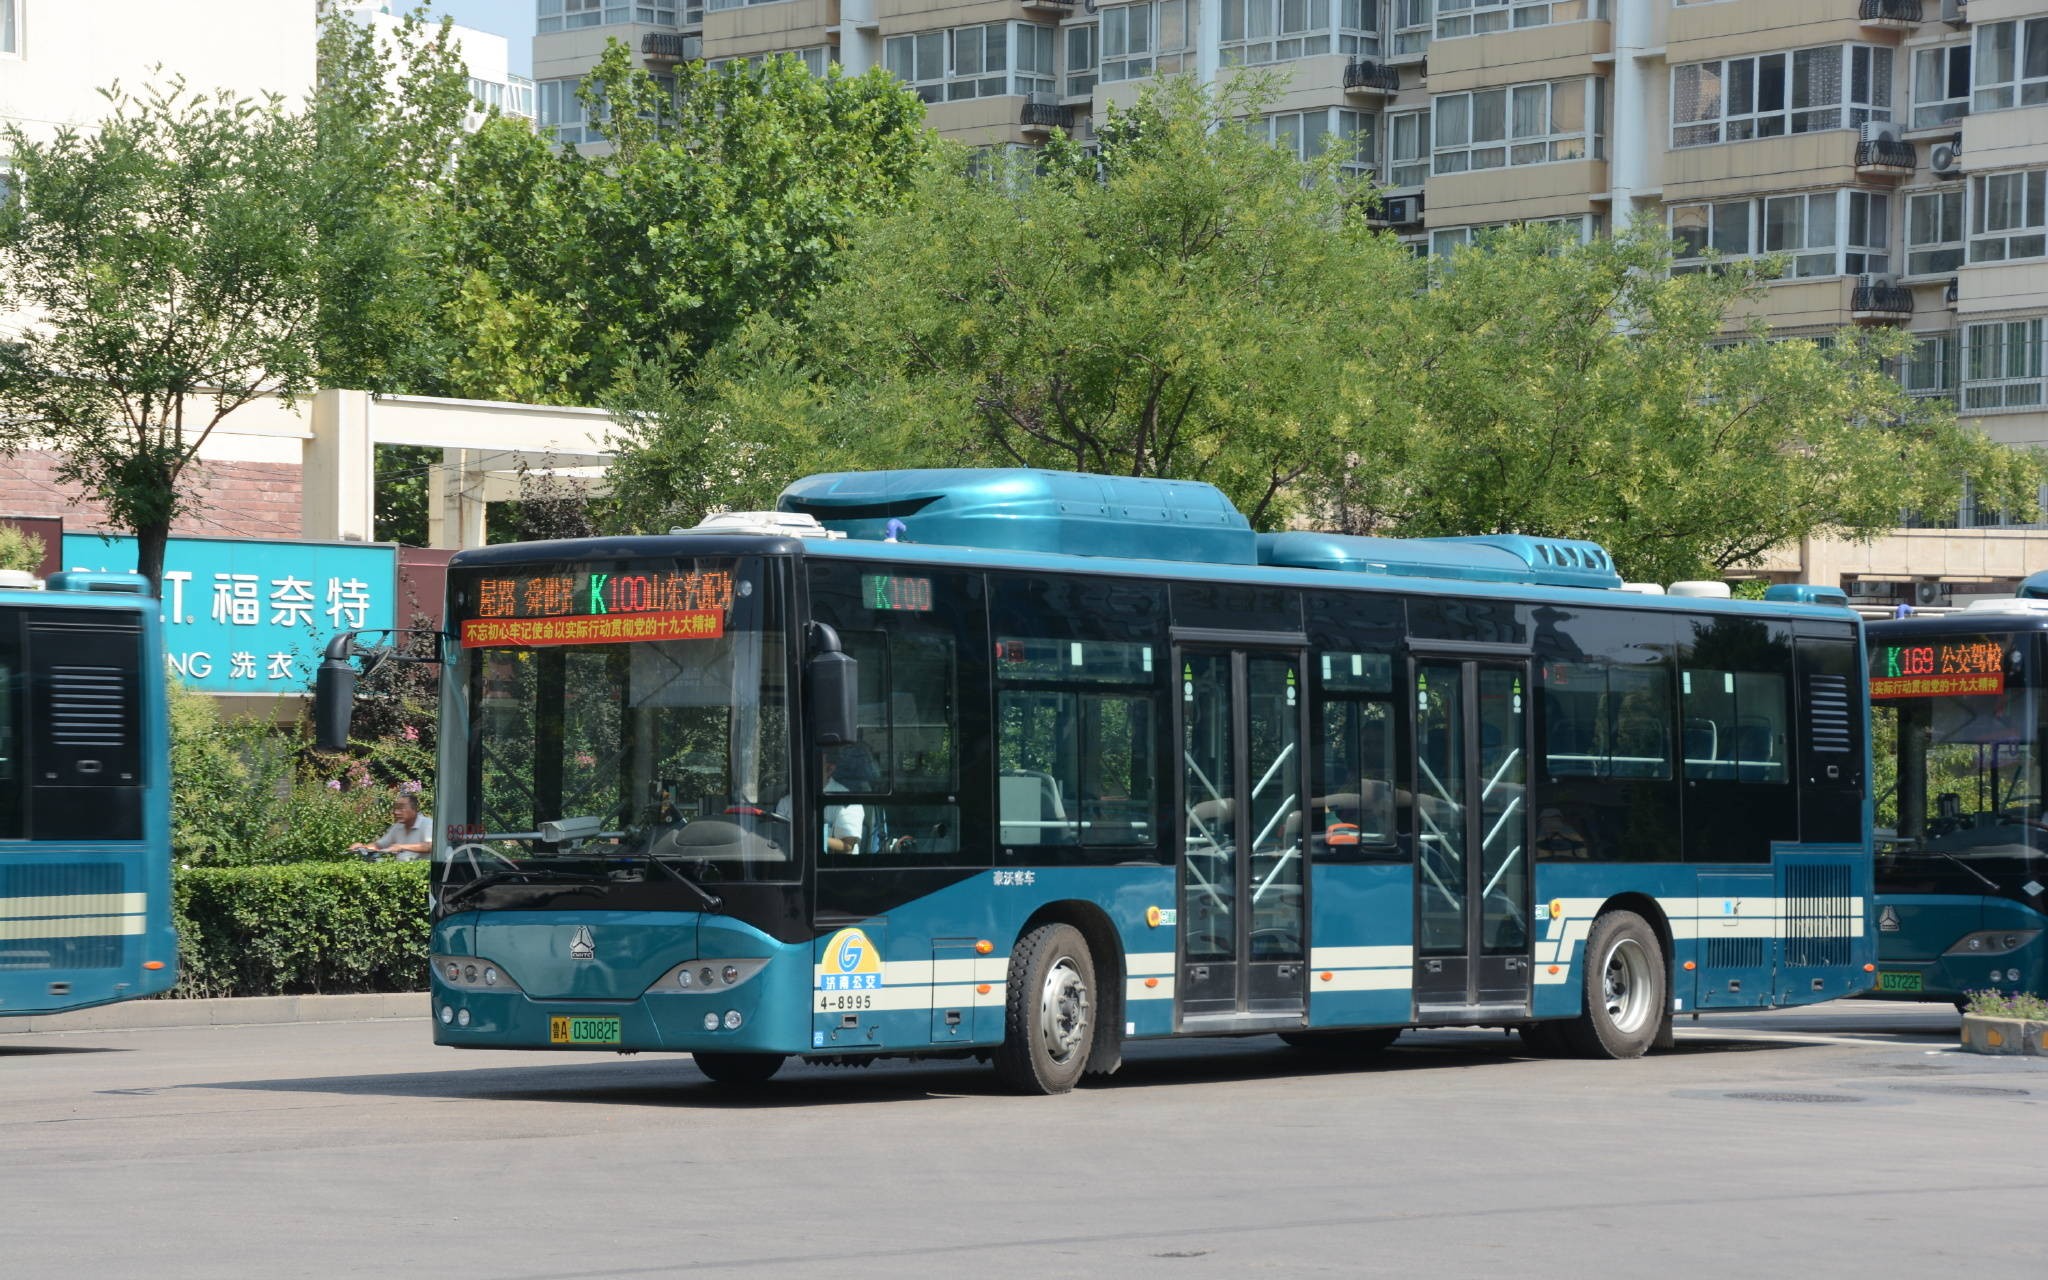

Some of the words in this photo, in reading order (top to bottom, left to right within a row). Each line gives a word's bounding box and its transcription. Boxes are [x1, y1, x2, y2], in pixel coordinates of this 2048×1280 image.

[212, 573, 370, 628] 福奈特
[591, 574, 646, 614] K100
[874, 575, 930, 610] K100
[467, 614, 716, 642] 不忘初心牢记使命以实际行动贯彻党的十九大精神
[230, 651, 293, 680] 洗衣
[1888, 646, 1934, 677] K169
[1941, 642, 2003, 673] 公交驾校
[993, 870, 1035, 886] 豪沃客车
[826, 975, 876, 990] 济南公交
[820, 995, 871, 1010] 4-8995
[573, 1021, 618, 1040] 03082F
